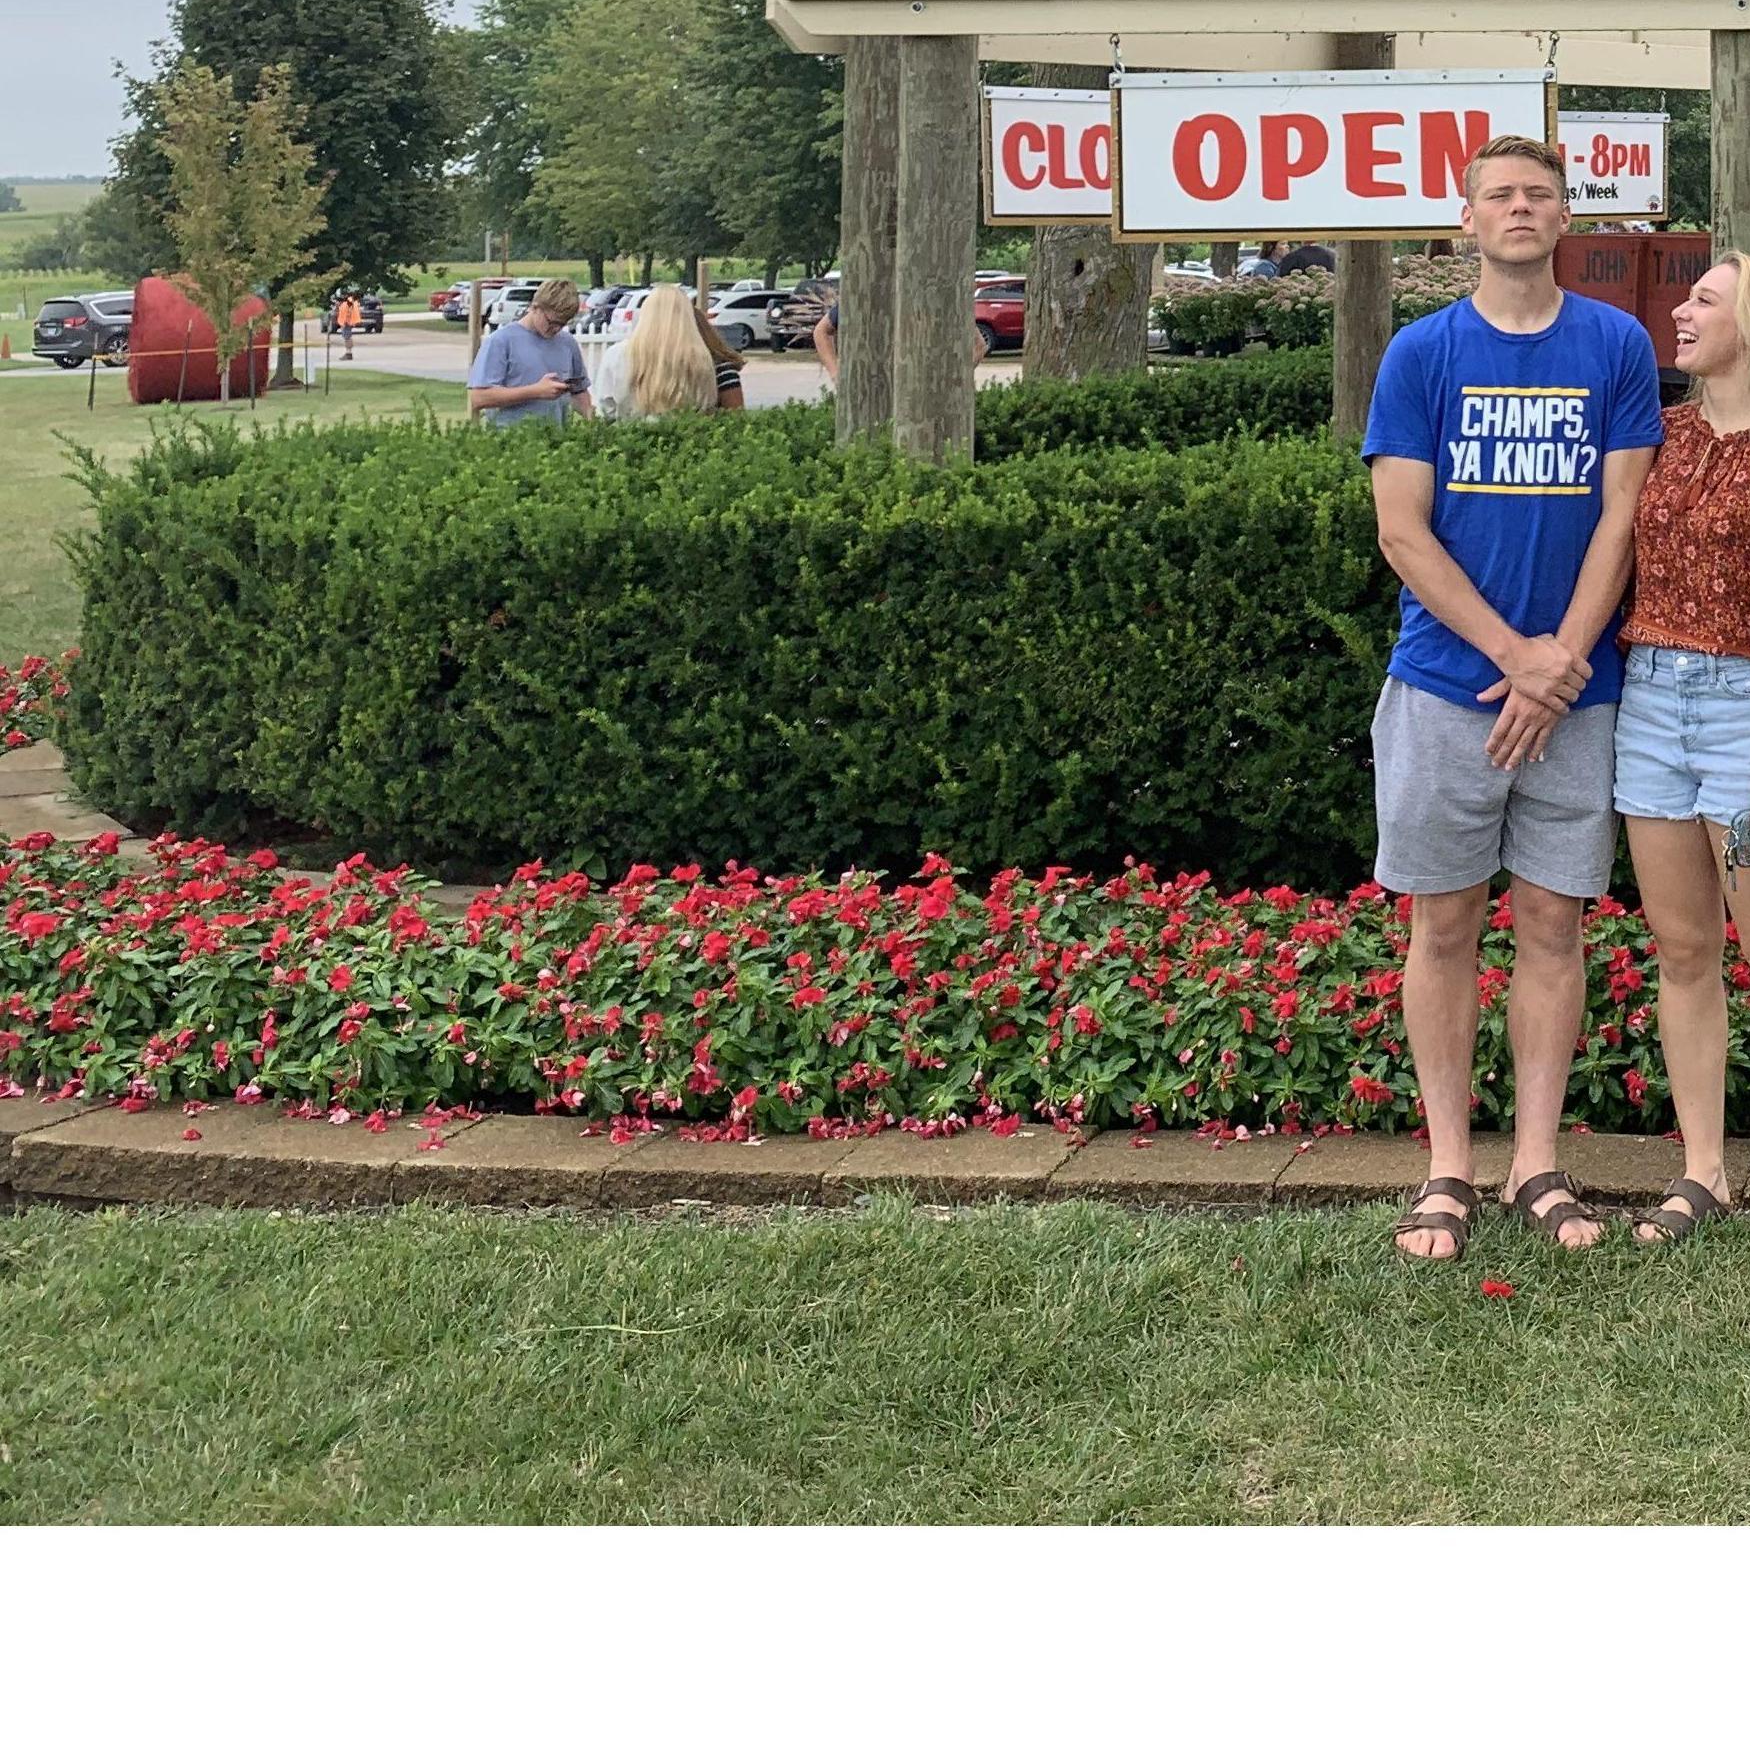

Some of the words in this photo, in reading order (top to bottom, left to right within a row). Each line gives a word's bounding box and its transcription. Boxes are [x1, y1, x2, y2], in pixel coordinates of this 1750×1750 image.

[1172, 109, 1490, 201] OPEN
[1590, 134, 1651, 178] 8PM
[1461, 396, 1589, 443] CHAMPS,
[1448, 440, 1482, 482] YA
[1492, 441, 1598, 485] KNOW?
